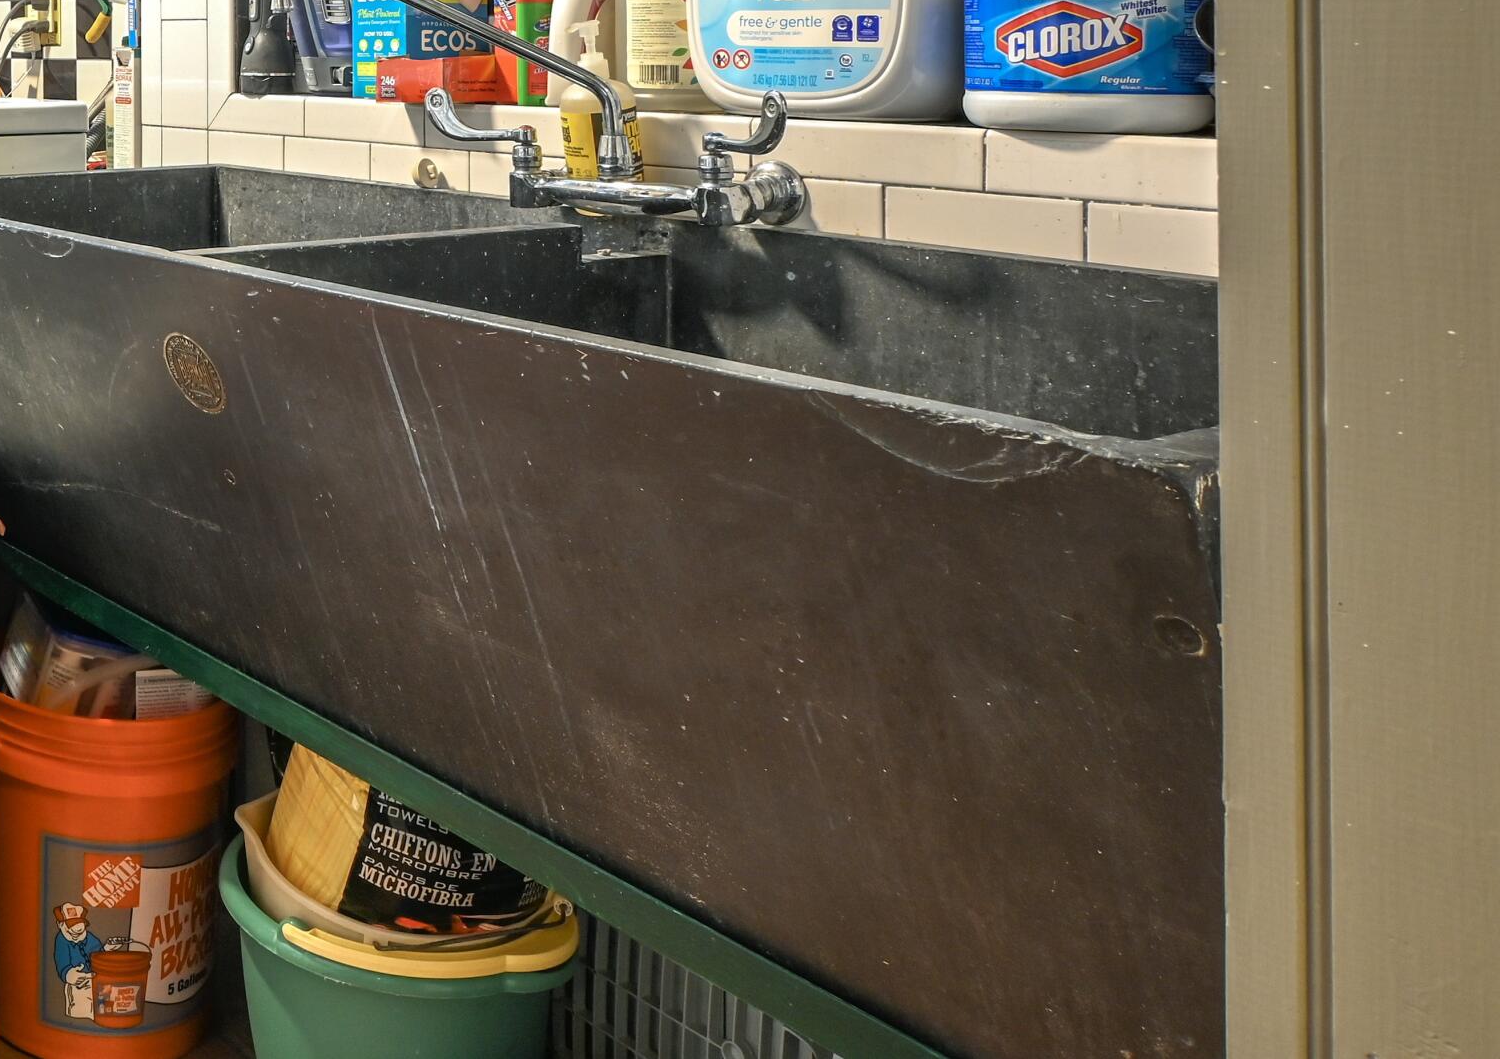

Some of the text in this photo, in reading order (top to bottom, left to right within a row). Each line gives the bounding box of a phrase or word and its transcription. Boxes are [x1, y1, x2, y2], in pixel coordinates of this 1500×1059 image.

[357, 6, 400, 18] Plant Powered
[739, 15, 822, 29] free & gentle
[1136, 5, 1167, 17] Whites
[421, 30, 476, 52] ECOS
[1007, 14, 1129, 63] CLOROX
[380, 76, 395, 85] 246
[1100, 75, 1140, 85] Regular
[377, 801, 449, 834] TOWELS
[370, 822, 497, 872] CHIFFONS EN
[88, 859, 115, 881] THE
[364, 856, 459, 892] PAÑOS DE
[368, 842, 482, 880] MICROFIBRE
[82, 856, 141, 907] HOME
[103, 874, 140, 908] DEPOT
[359, 862, 475, 907] MICROFIBRA
[168, 982, 175, 995] 5
